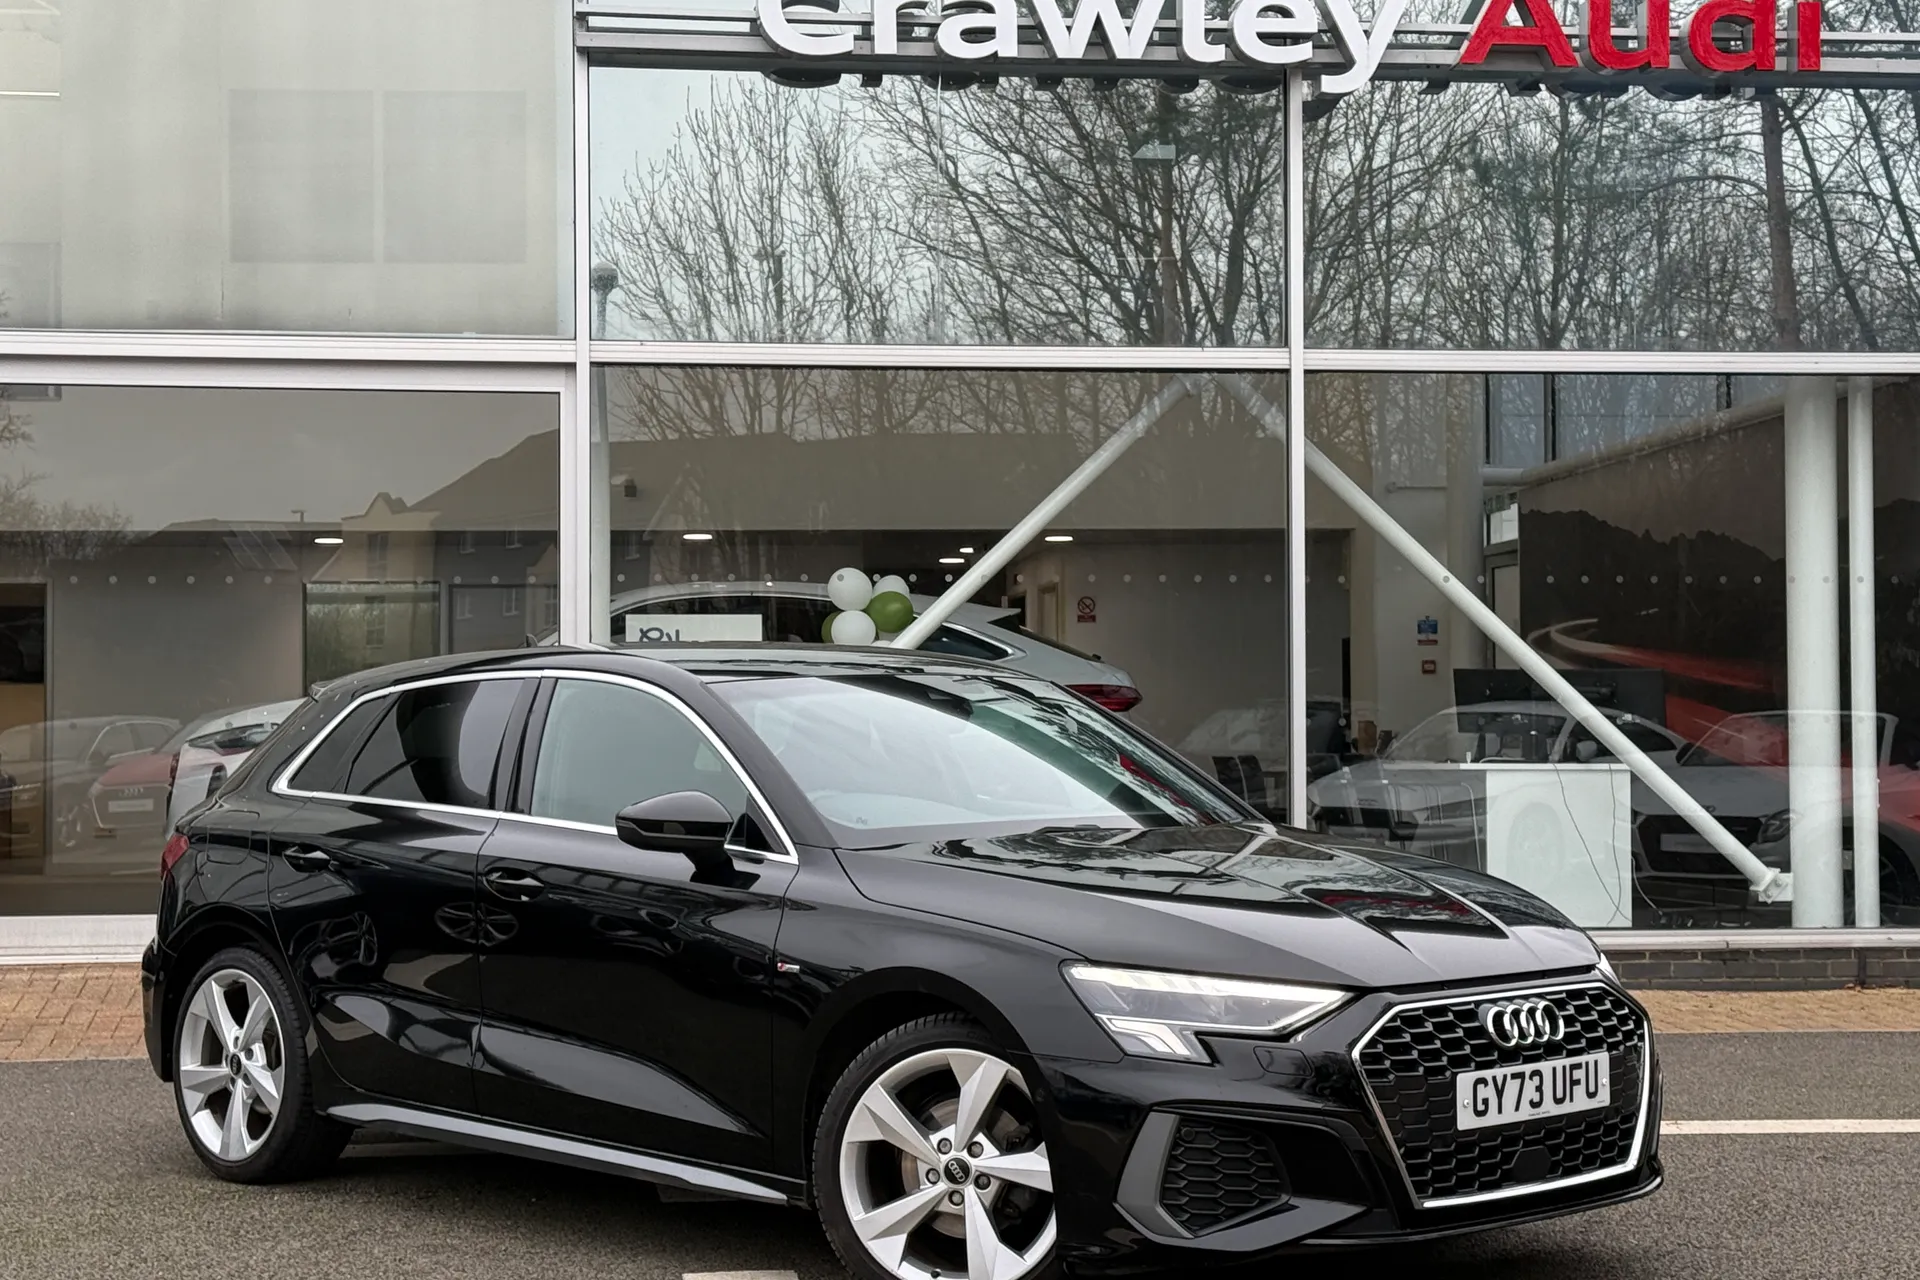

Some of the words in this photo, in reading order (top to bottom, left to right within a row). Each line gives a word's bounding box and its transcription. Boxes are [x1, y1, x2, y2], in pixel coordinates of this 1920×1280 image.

[757, 0, 1406, 93] Crawley
[1460, 0, 1821, 72] Audi
[1472, 1069, 1544, 1118] GY73
[1552, 1059, 1599, 1106] UFU
